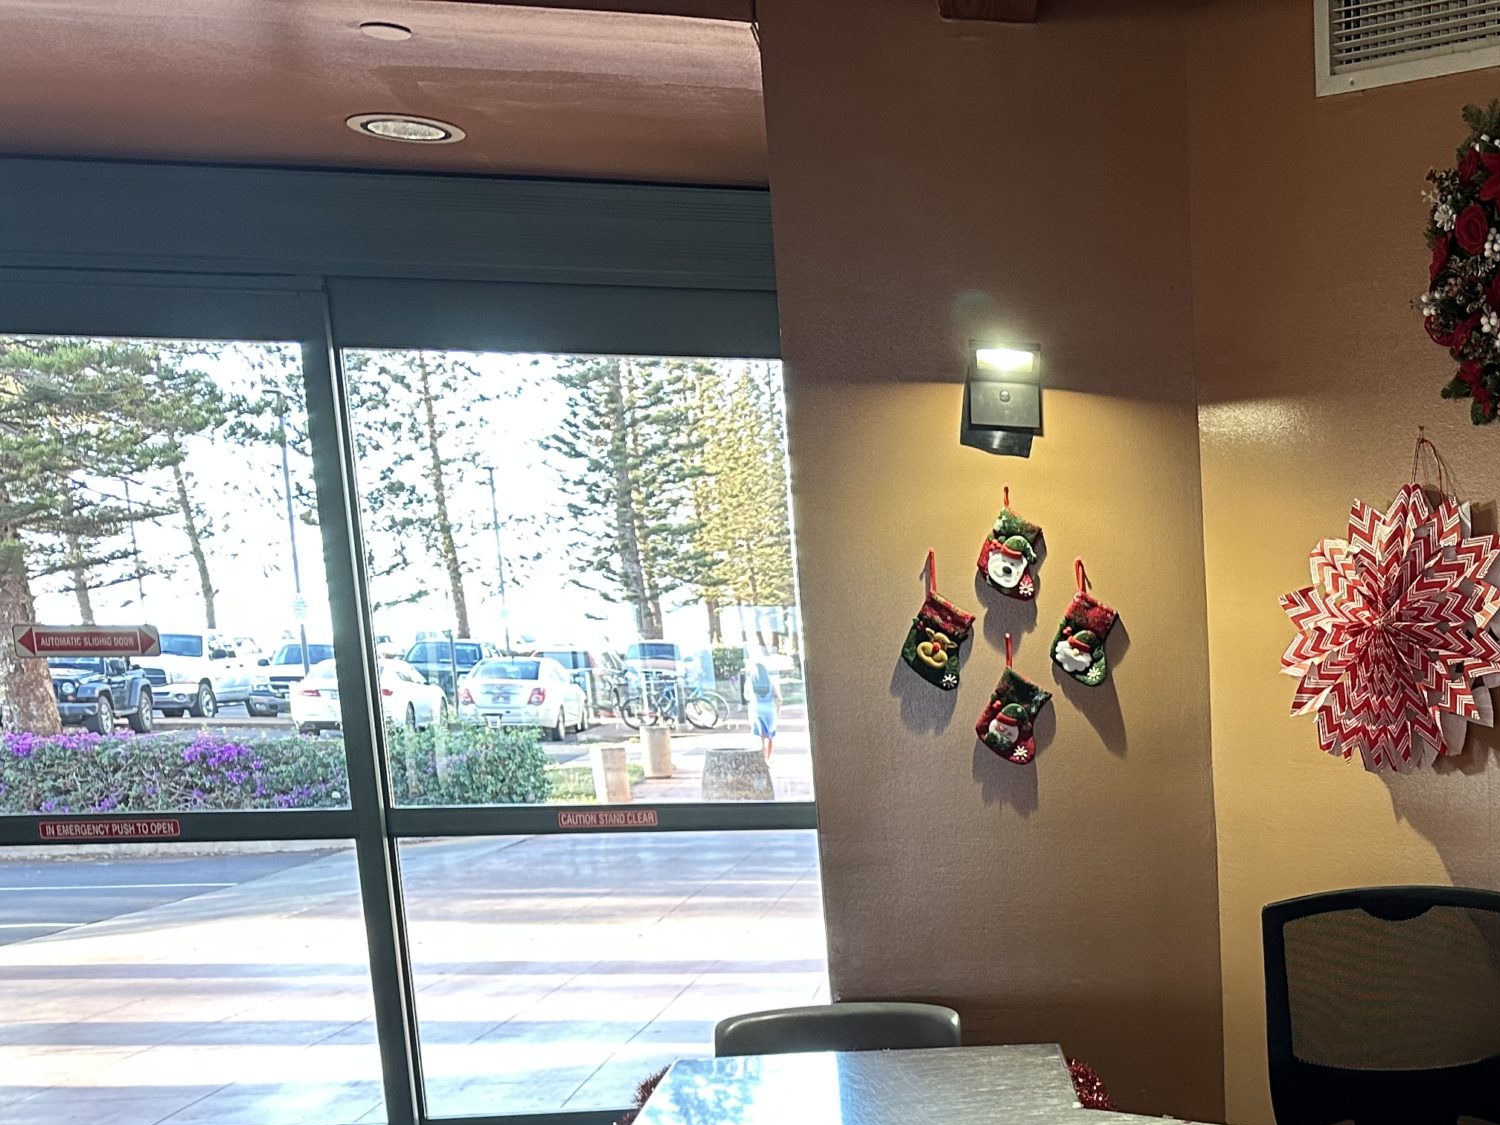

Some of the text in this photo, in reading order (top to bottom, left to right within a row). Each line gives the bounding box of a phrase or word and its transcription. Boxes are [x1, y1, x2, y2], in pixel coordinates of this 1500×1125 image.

[40, 636, 134, 646] AUTOMATIC SLIDING DOOR
[561, 812, 654, 826] CAUTION STAND CLEAR
[46, 822, 174, 836] IN EMERGENCY PUSH TO OPEN
